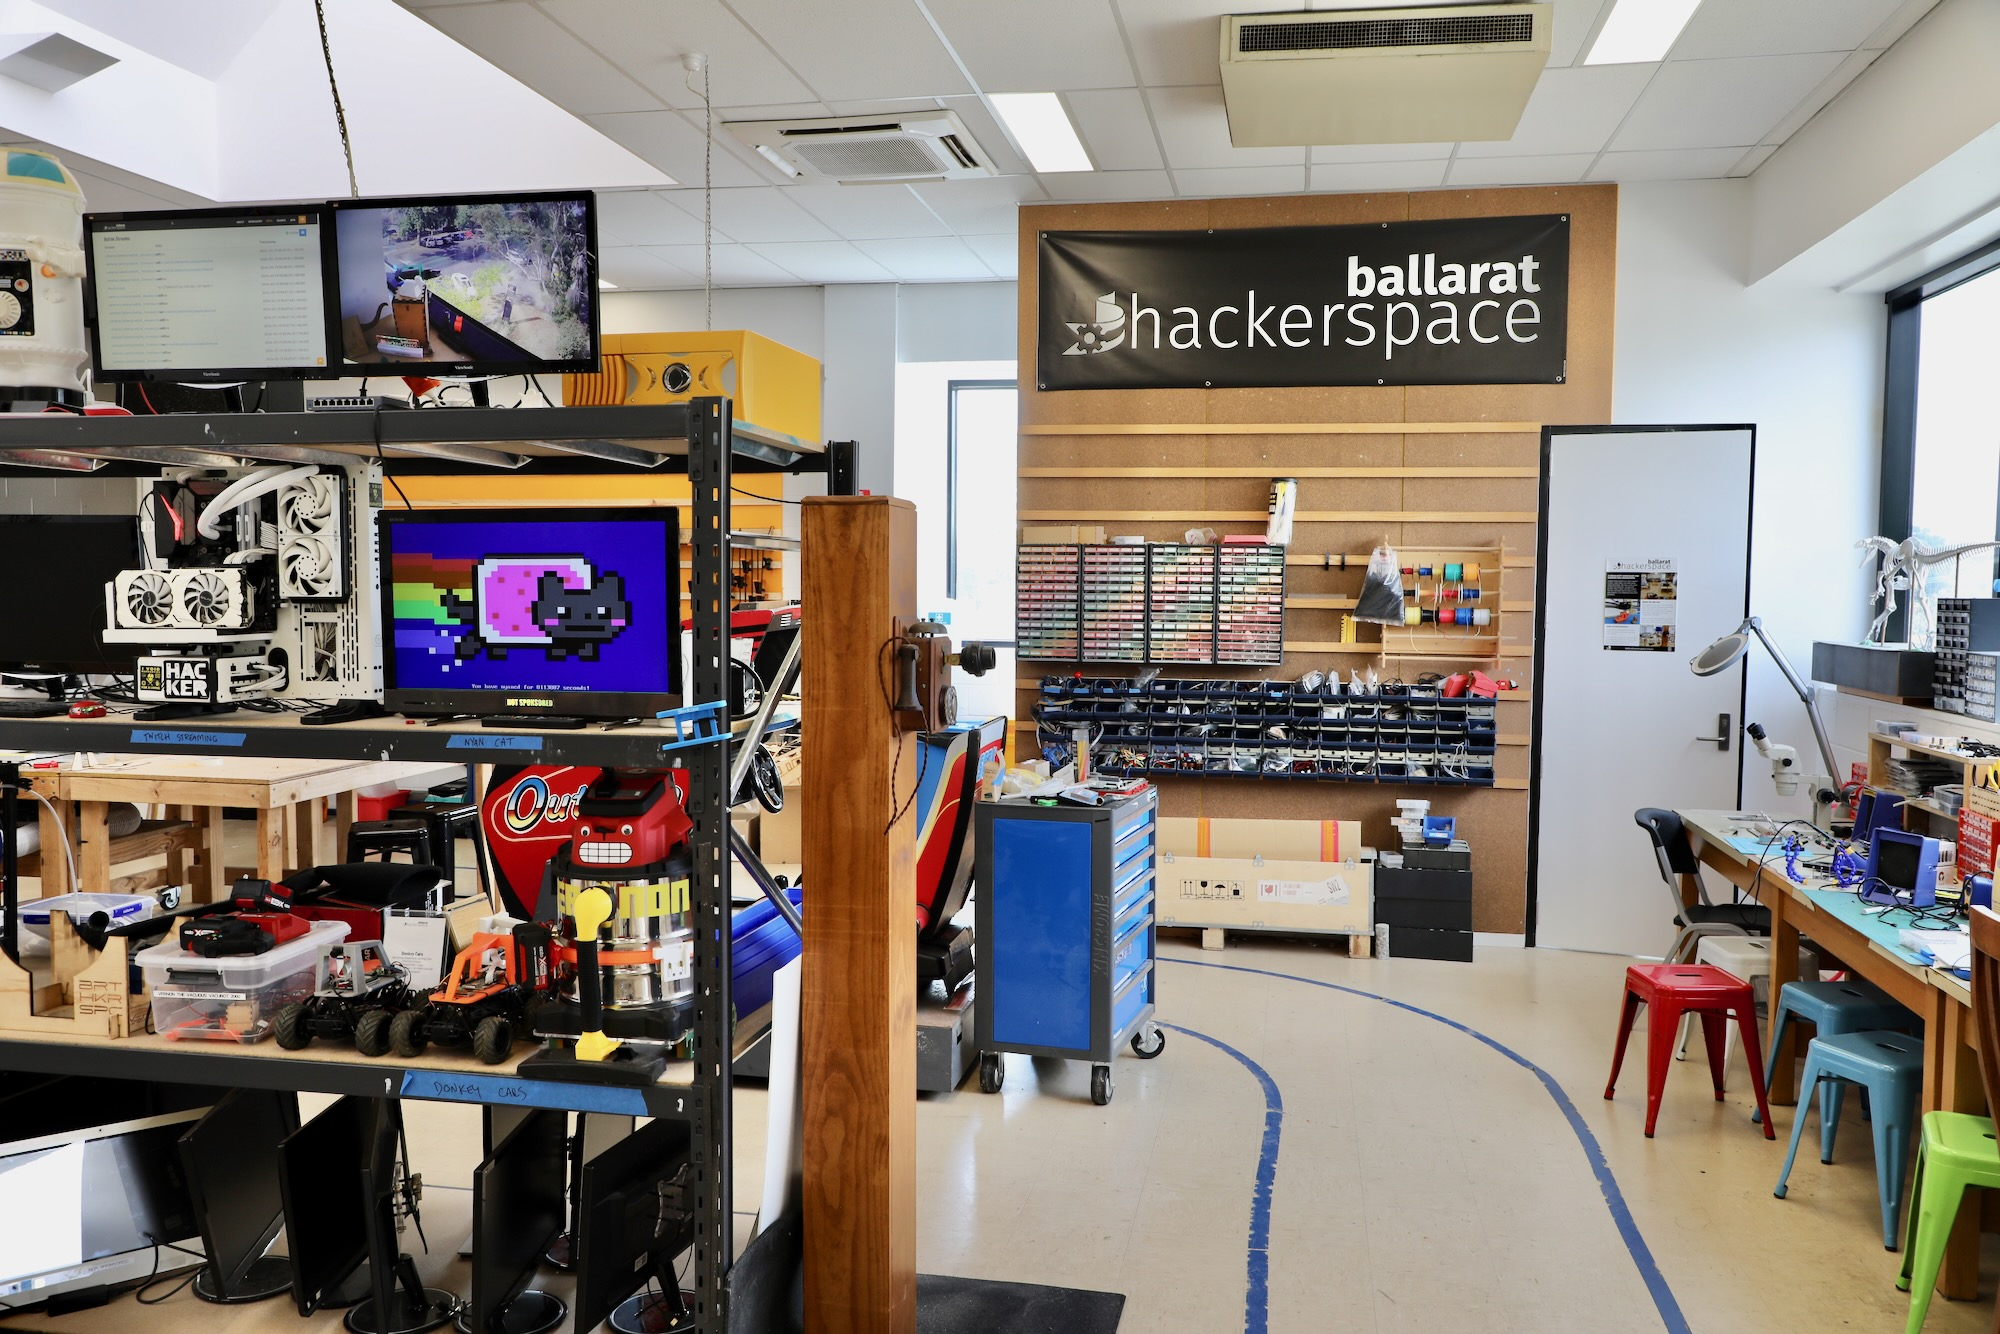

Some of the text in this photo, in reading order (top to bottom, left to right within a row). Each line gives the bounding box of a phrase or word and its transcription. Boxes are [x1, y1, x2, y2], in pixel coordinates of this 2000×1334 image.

[1347, 253, 1541, 298] ballarat
[1131, 289, 1542, 360] hackerspace
[1621, 562, 1671, 570] hackerspace
[166, 662, 207, 680] HAC
[166, 679, 208, 697] KER
[519, 699, 553, 707] SPONSORED
[144, 732, 218, 742] TWITCH STREAMING
[464, 737, 516, 747] NYAN CAT
[1092, 893, 1110, 977] KINCROME
[79, 980, 122, 991] BRT
[80, 992, 122, 1004] HKR
[433, 1081, 527, 1100] DONKEY CARS
